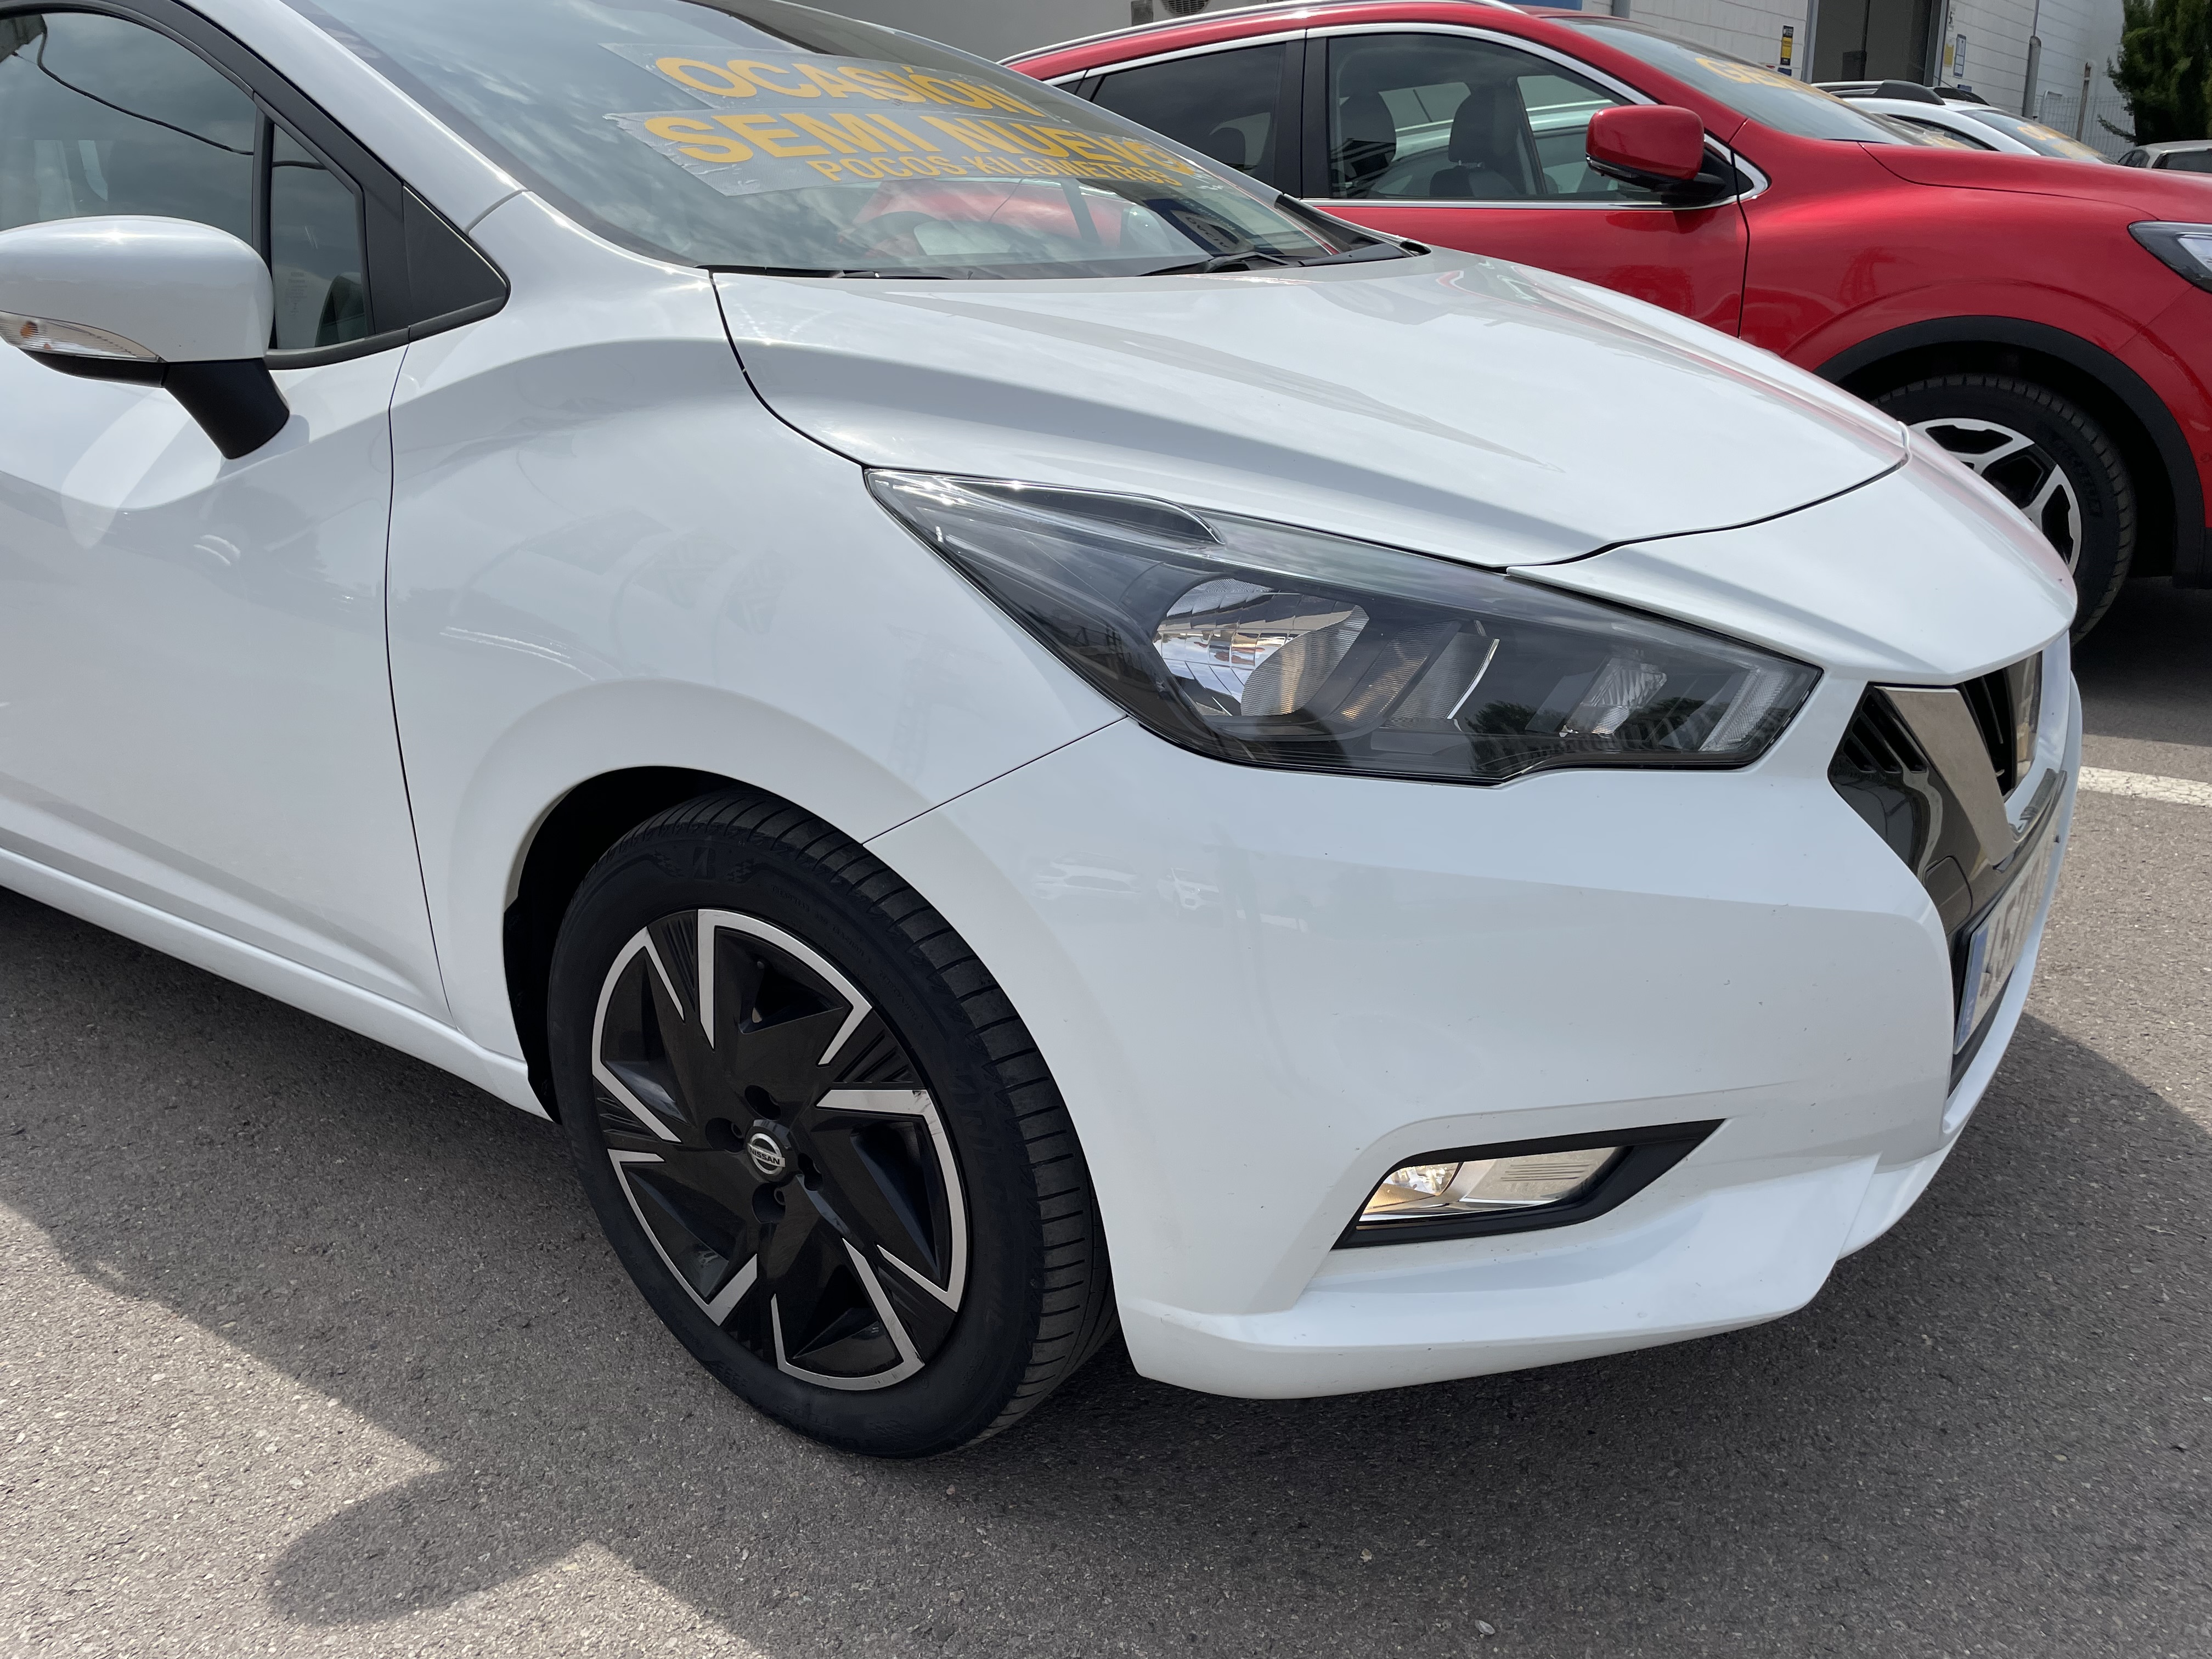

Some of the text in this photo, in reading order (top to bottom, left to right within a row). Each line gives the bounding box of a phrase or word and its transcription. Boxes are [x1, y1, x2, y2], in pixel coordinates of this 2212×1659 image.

[656, 58, 1046, 117] OCASIÓN
[645, 113, 1194, 175] SEMI NUEVO
[806, 156, 1183, 187] POCOS KILOMETROS
[749, 1147, 780, 1165] NISSAN
